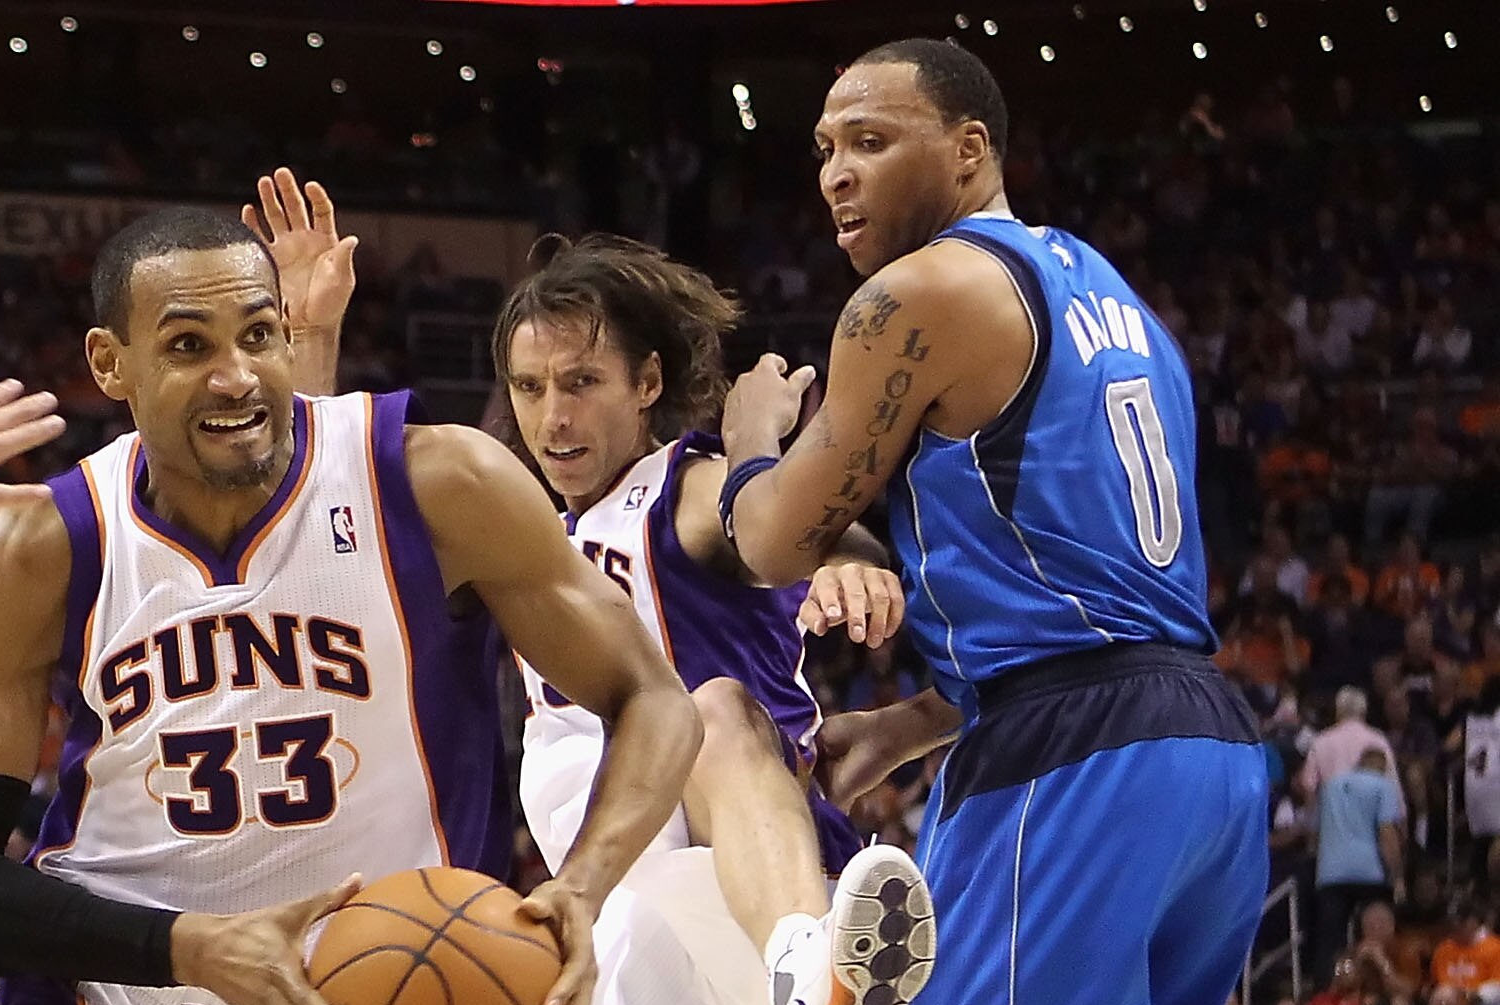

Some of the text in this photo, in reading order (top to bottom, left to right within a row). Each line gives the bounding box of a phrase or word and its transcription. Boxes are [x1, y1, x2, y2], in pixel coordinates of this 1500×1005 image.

[1106, 378, 1182, 567] 0
[100, 611, 373, 737] SUNS
[158, 711, 339, 839] 33
